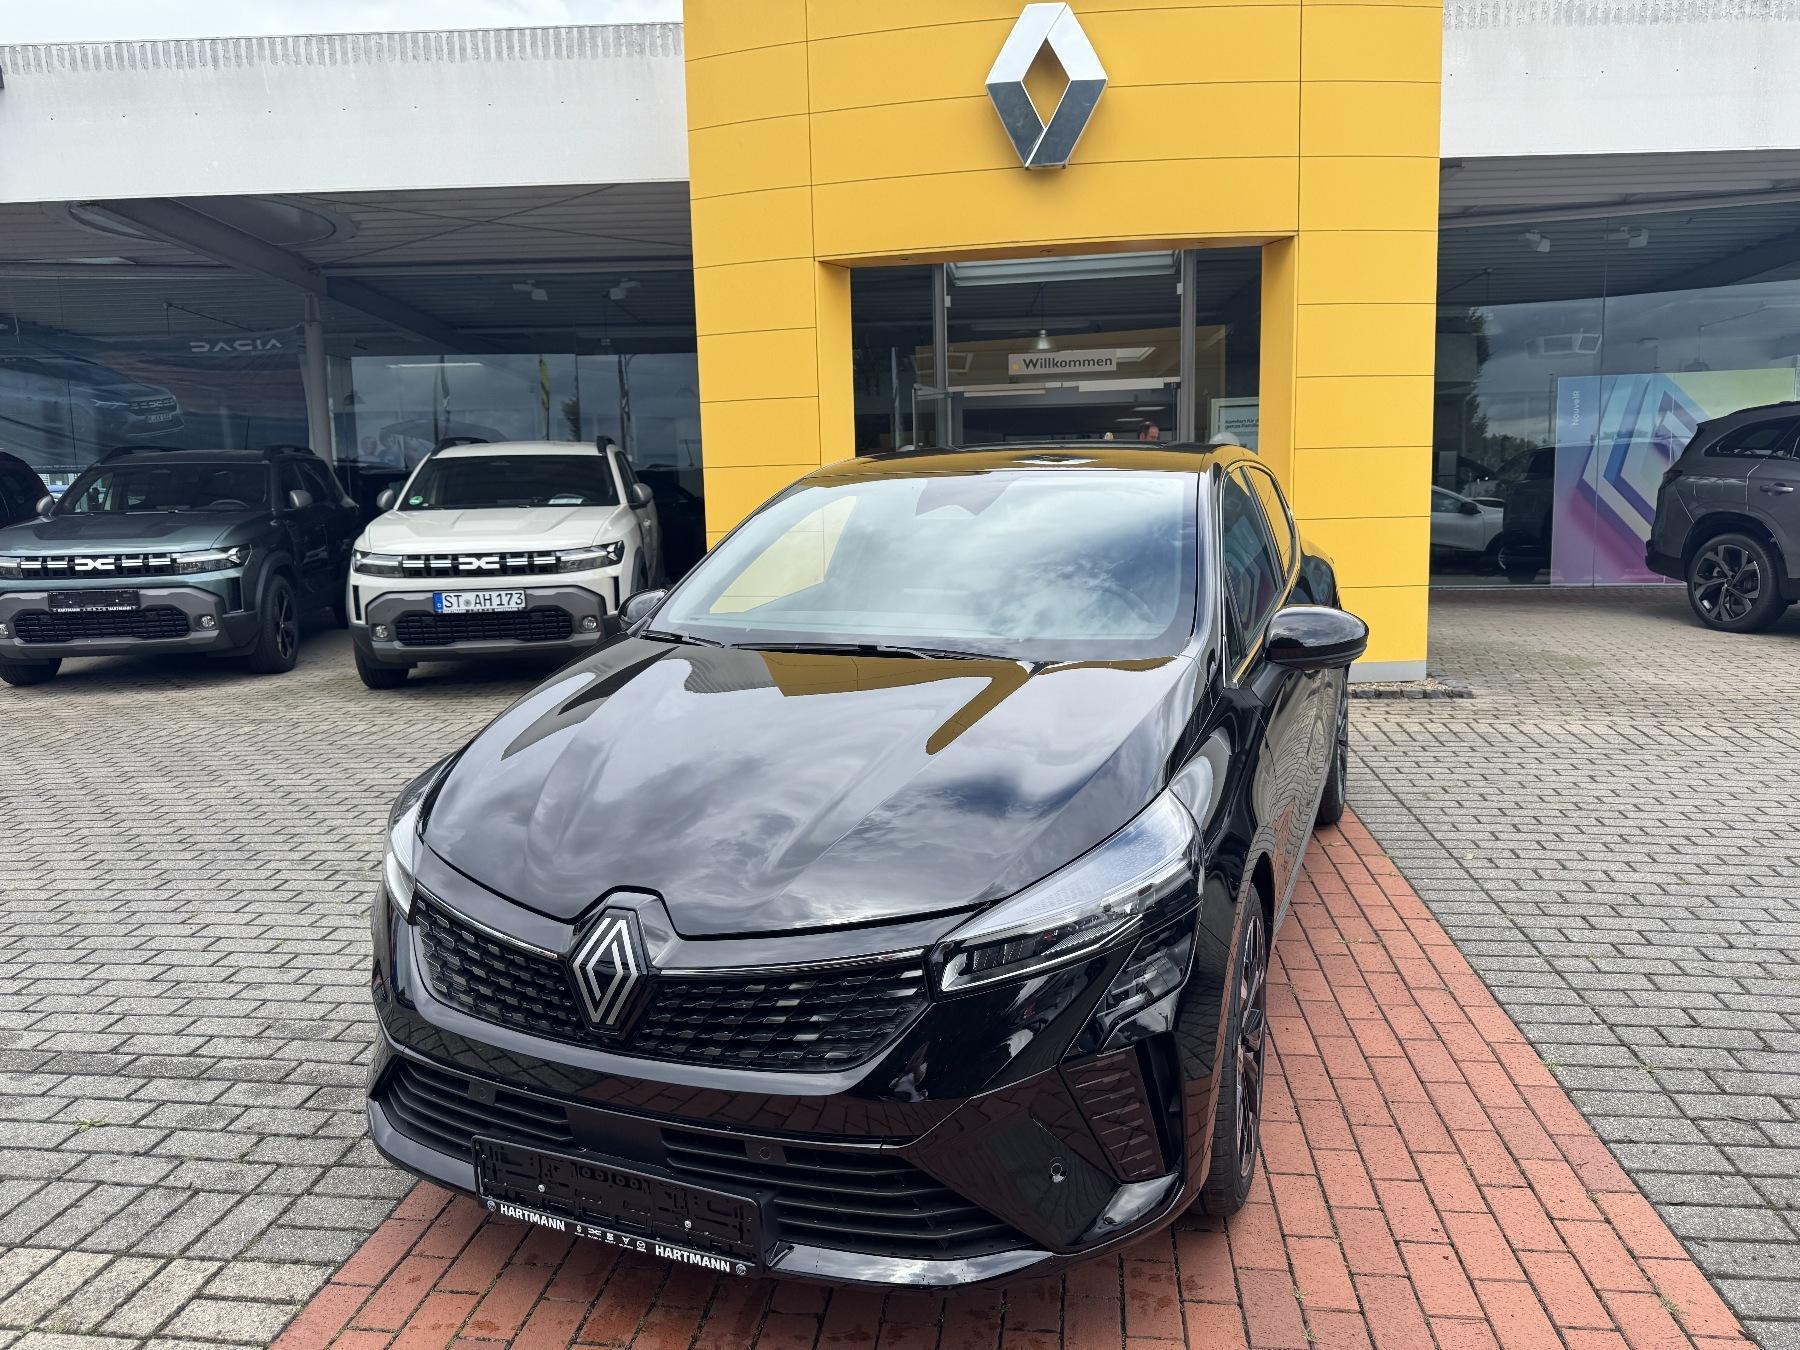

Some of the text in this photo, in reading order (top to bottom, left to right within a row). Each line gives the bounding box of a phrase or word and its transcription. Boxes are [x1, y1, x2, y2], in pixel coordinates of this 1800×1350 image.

[189, 338, 283, 353] DACIA
[1022, 357, 1113, 370] Willkommen
[444, 594, 462, 609] ST
[474, 593, 493, 608] AH
[496, 592, 524, 607] 173
[500, 1203, 731, 1273] HARTMANN HARTMANN
